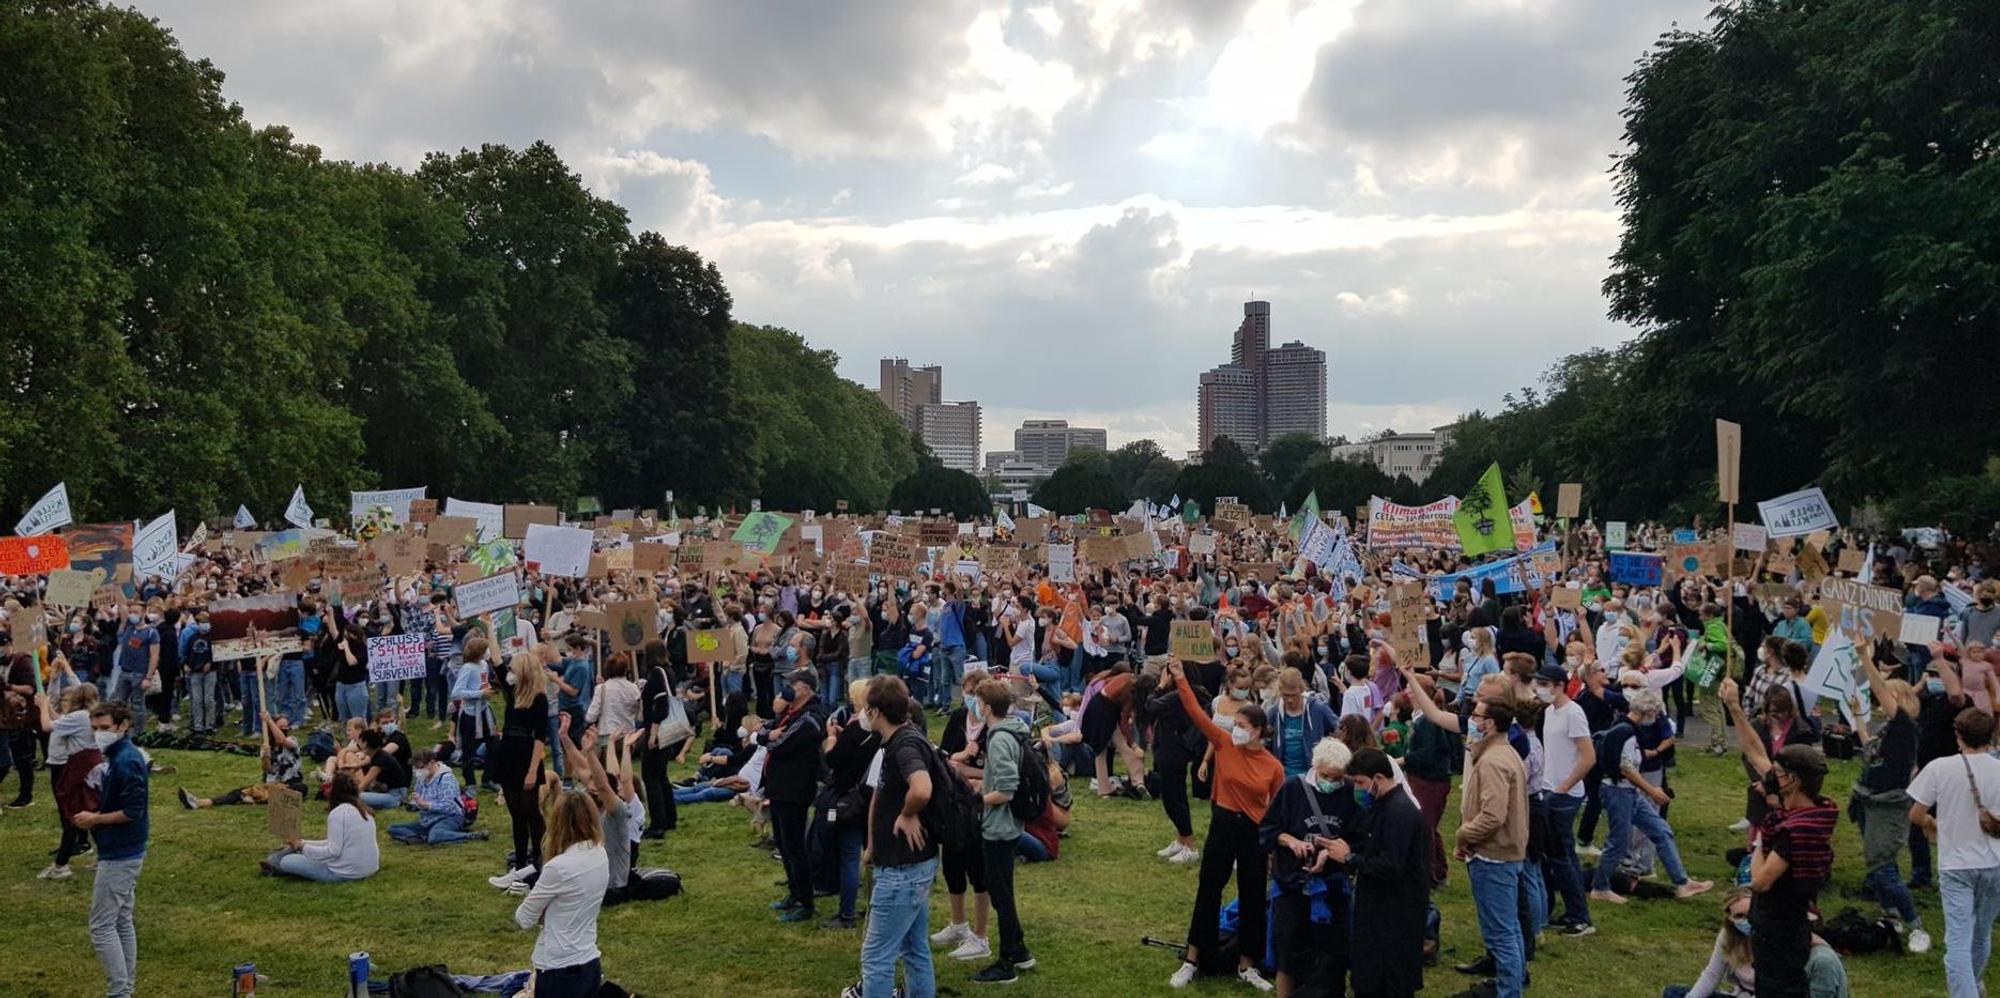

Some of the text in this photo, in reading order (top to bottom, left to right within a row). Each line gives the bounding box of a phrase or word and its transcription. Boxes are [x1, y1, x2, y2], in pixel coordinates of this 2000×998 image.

[1821, 577, 1857, 604] GANZ
[1841, 603, 1874, 637] EIS
[371, 635, 420, 647] SCHLUSS
